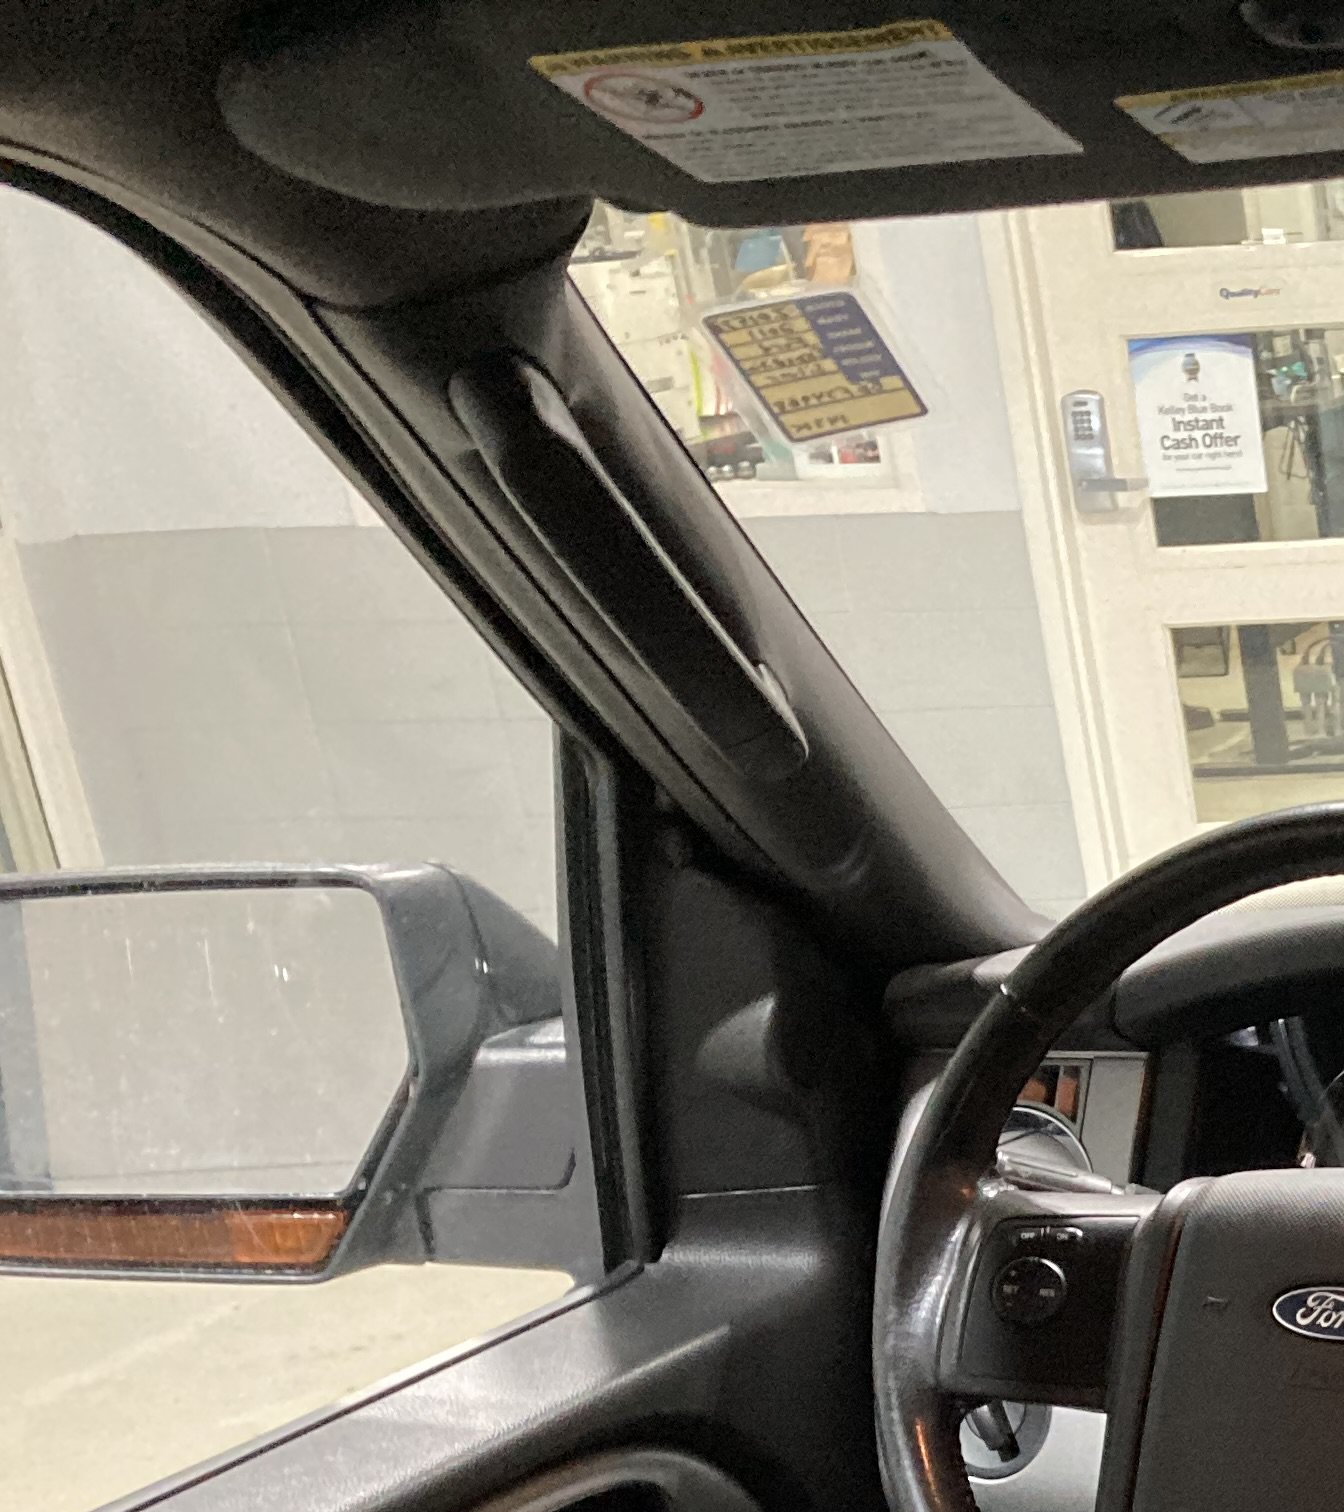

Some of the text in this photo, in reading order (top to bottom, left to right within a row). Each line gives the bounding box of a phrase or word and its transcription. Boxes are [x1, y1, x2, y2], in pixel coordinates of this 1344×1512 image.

[1187, 403, 1208, 414] Blue
[1209, 402, 1234, 413] Book
[1171, 416, 1226, 432] Instant
[1160, 432, 1242, 450] Cash Offer
